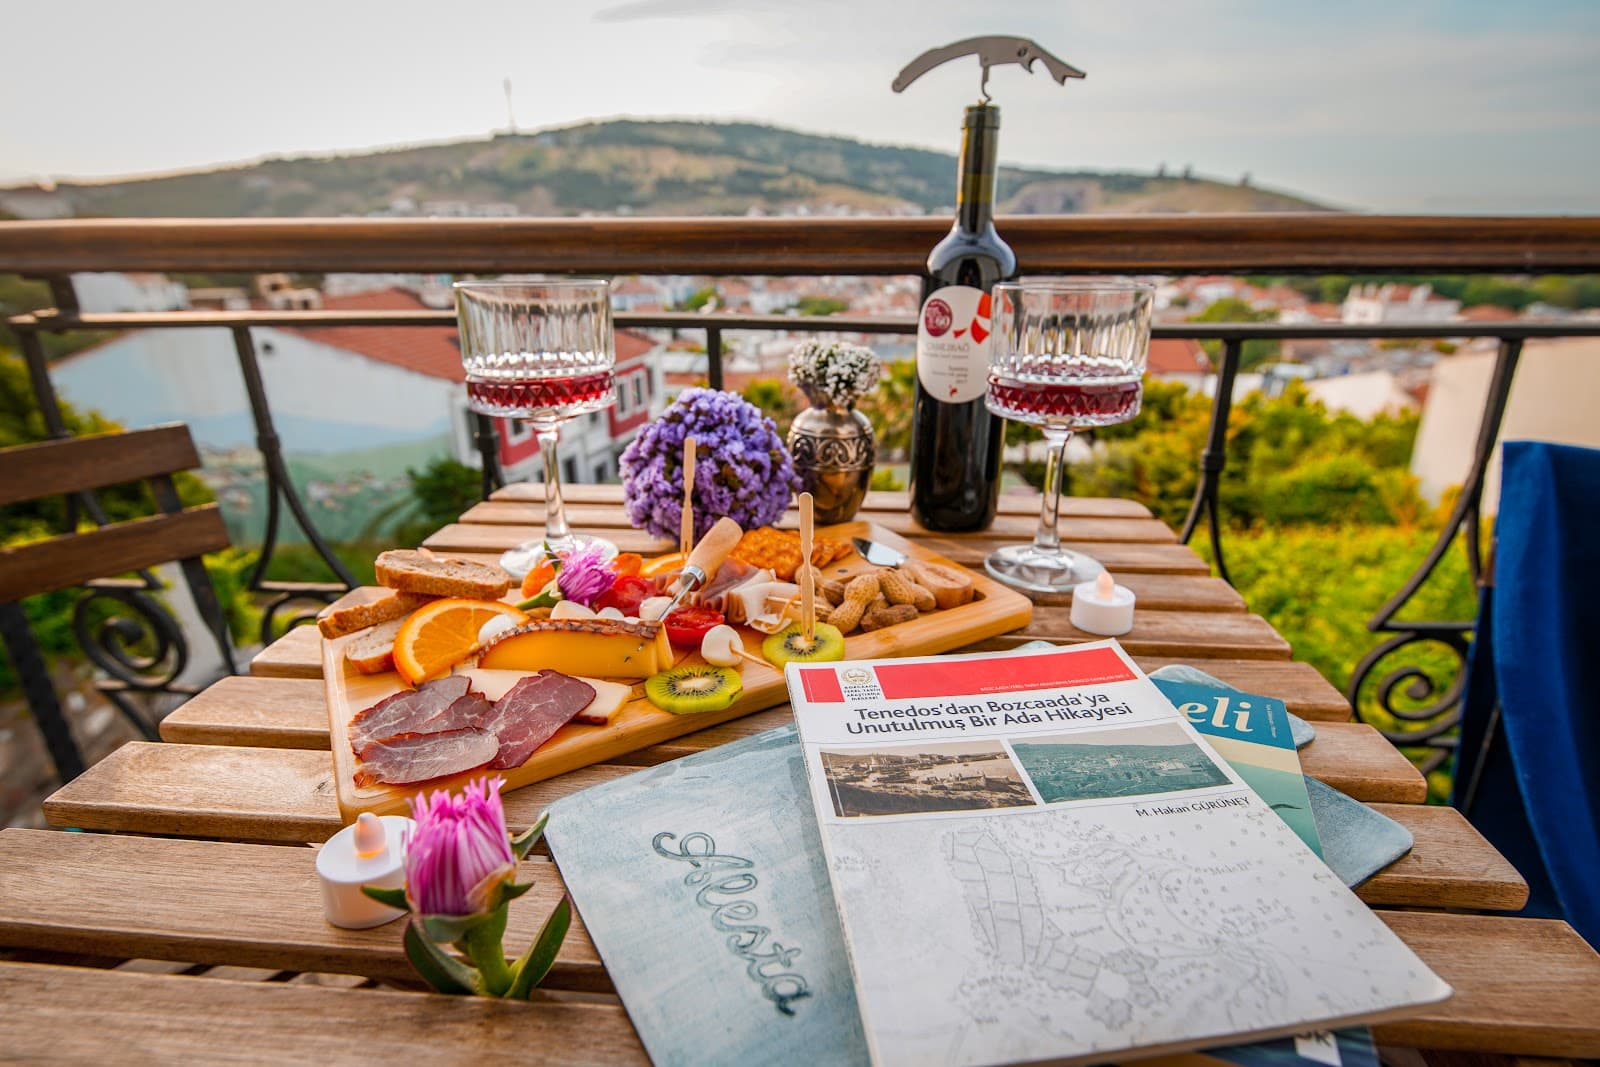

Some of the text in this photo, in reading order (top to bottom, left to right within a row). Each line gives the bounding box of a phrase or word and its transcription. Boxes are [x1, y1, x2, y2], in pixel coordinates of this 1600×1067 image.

[846, 702, 1134, 735] Unutulmuş Bir Ada Hikayesi
[854, 693, 1111, 721] Tenedos'dan Bozcaada'ya
[1178, 696, 1254, 732] eli
[1135, 796, 1251, 817] M. Hakan GÜRÜNEY
